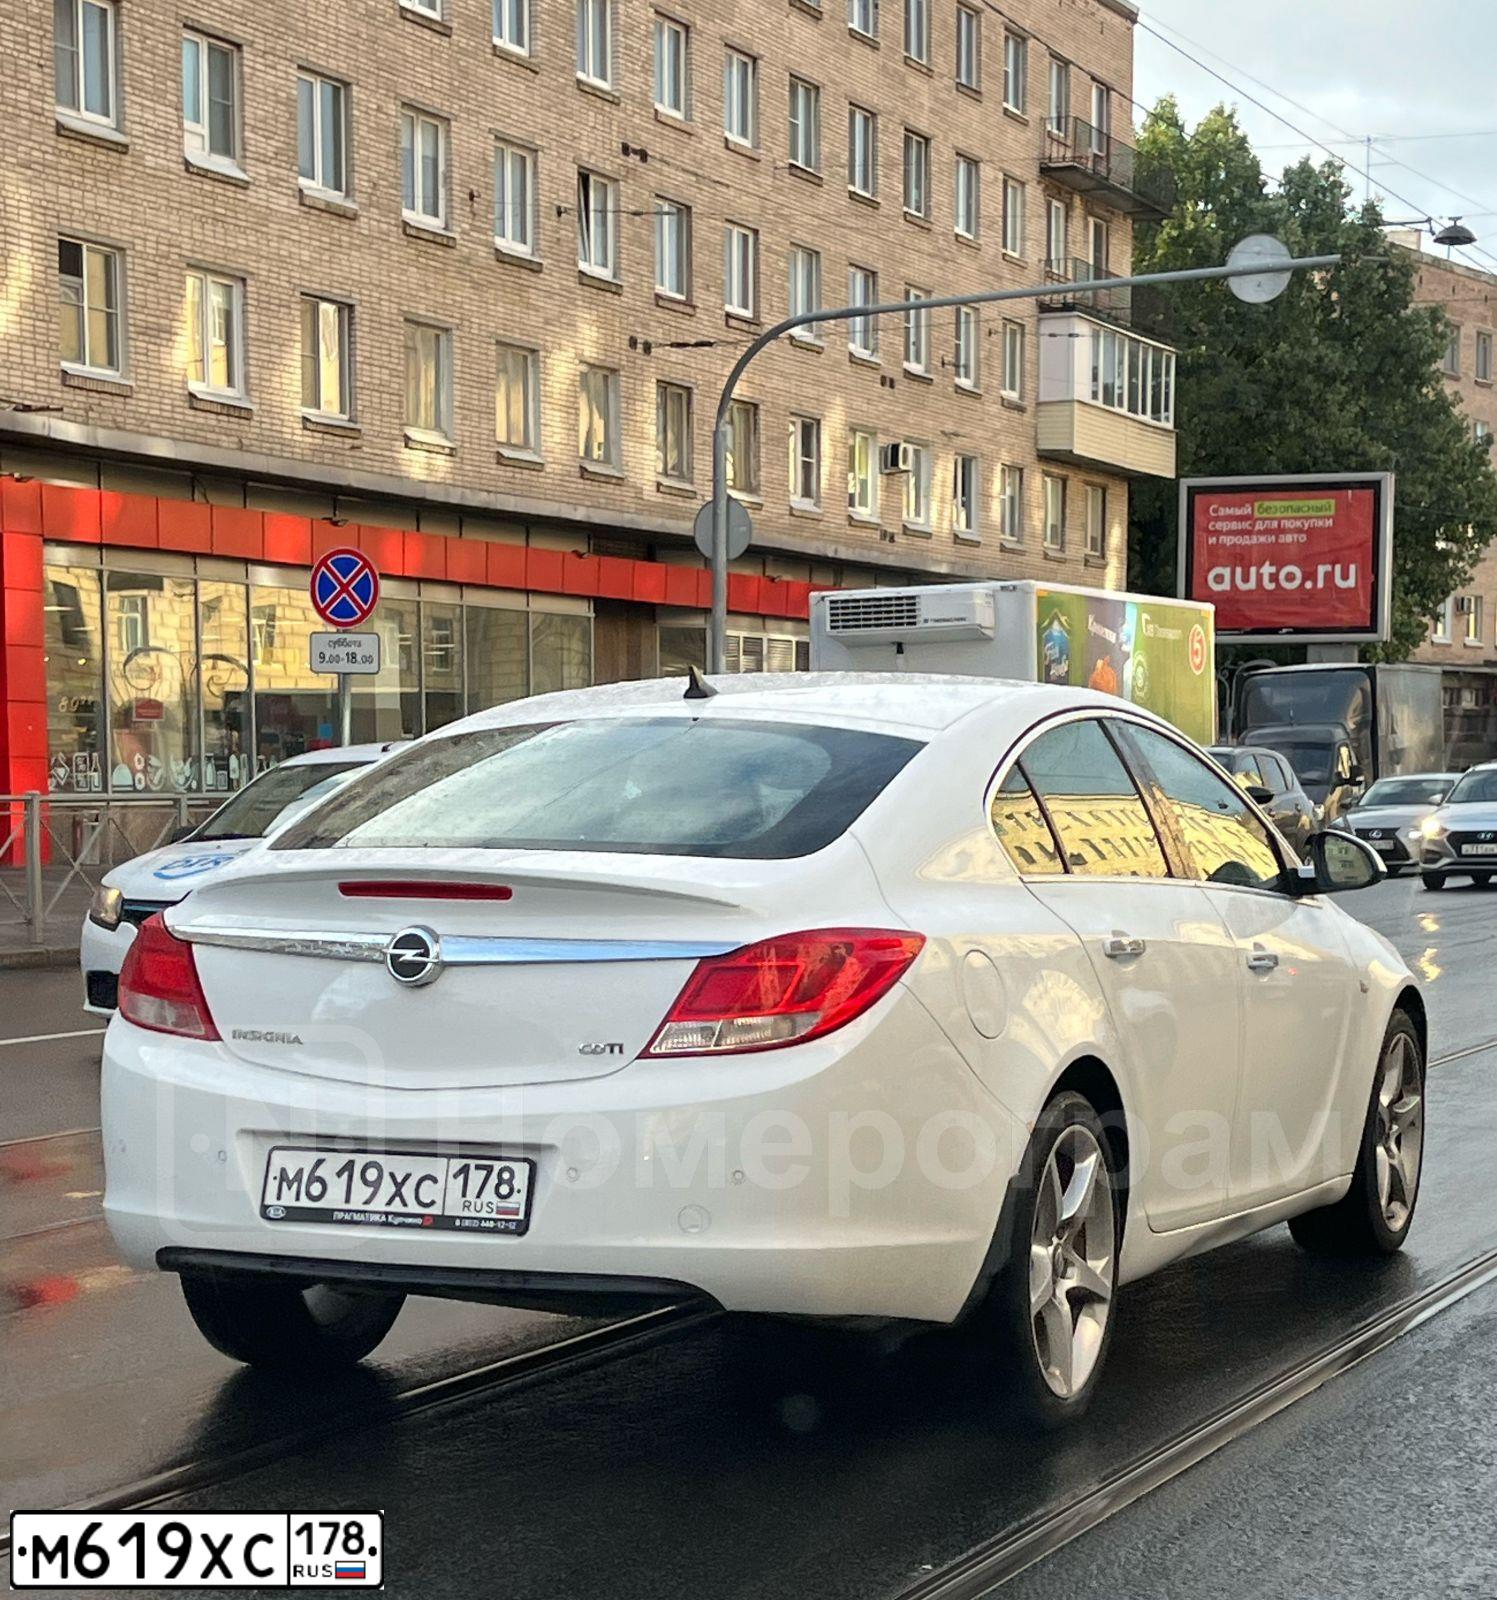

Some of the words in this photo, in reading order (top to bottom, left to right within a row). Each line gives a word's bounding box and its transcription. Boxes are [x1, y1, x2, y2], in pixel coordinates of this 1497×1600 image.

[1208, 503, 1252, 516] Самый
[1257, 501, 1332, 515] безопасный
[1208, 520, 1253, 532] сервис
[1254, 519, 1278, 531] для
[1280, 517, 1333, 531] покупки
[1208, 536, 1217, 545] и
[1218, 534, 1275, 546] продажи
[1277, 533, 1308, 543] авто
[1207, 561, 1357, 592] auto.ru
[327, 637, 362, 649] суббота
[231, 1029, 304, 1045] INSIGNIA
[275, 1158, 439, 1208] М619ХС
[453, 1163, 516, 1200] 178
[462, 1200, 494, 1214] RUS
